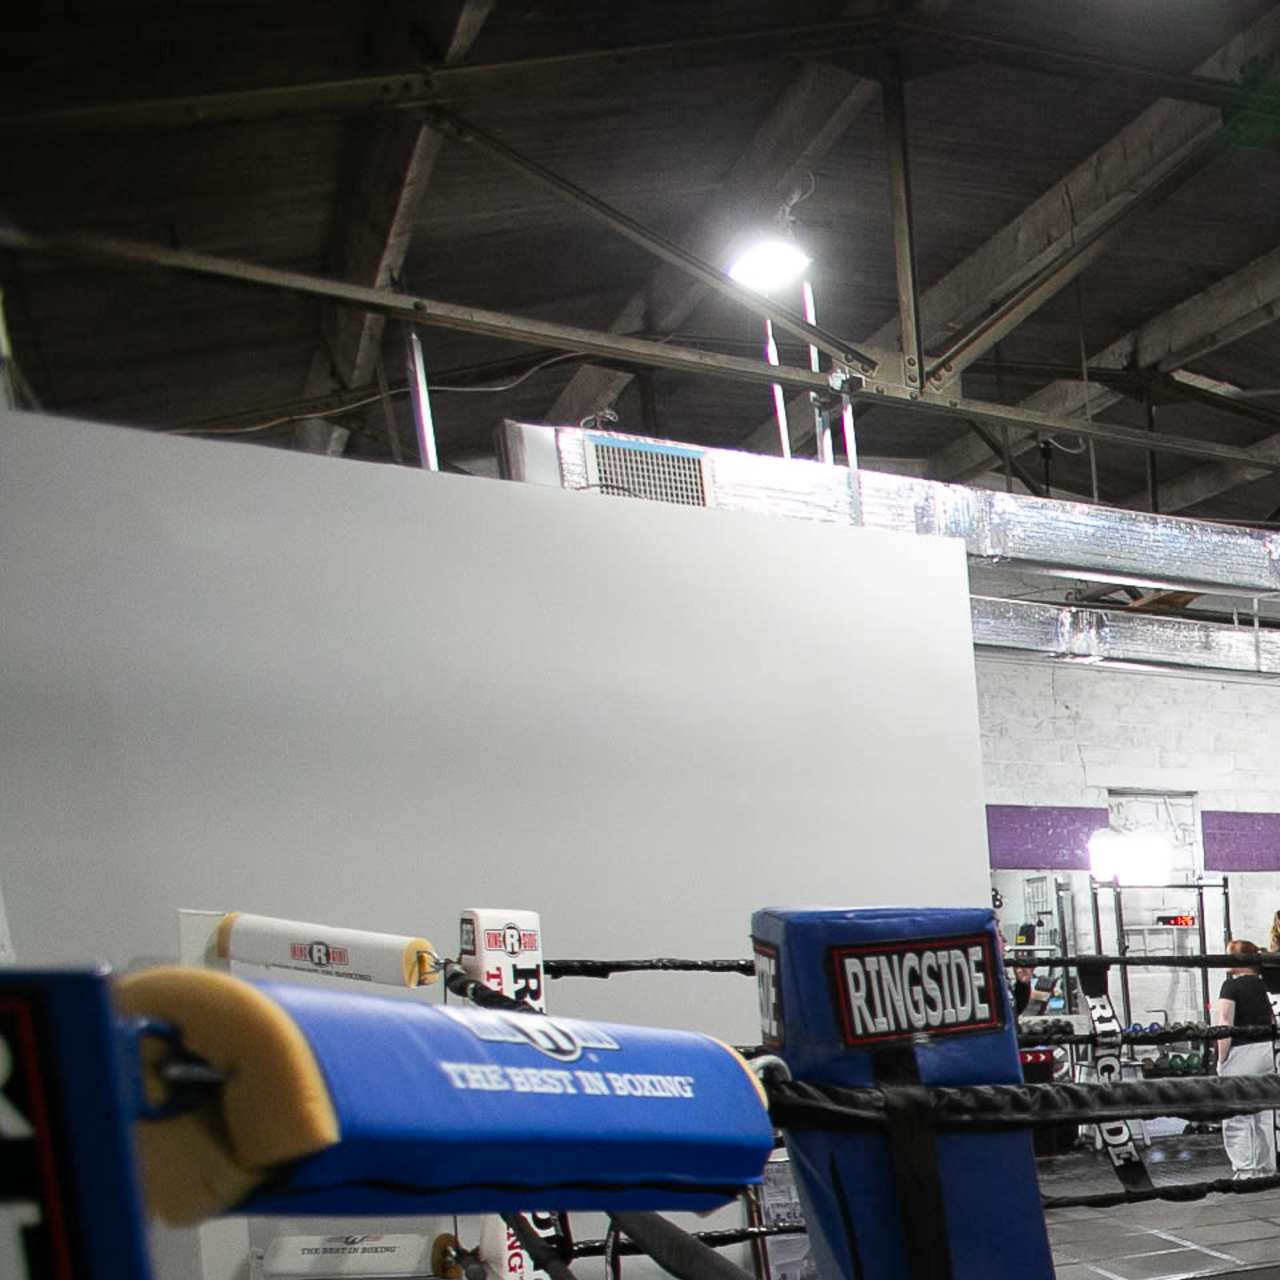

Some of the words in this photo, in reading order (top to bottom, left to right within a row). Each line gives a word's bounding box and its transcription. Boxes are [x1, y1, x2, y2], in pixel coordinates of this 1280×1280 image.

[844, 946, 989, 1036] RINGSIDE
[440, 1062, 504, 1092] THE
[510, 1068, 576, 1094] BEST
[576, 1070, 609, 1095] IN
[610, 1072, 694, 1098] BOXING
[1086, 994, 1141, 1167] RINGDE
[301, 1247, 324, 1256] THE
[347, 1246, 360, 1255] IN
[361, 1246, 397, 1255] BOXING
